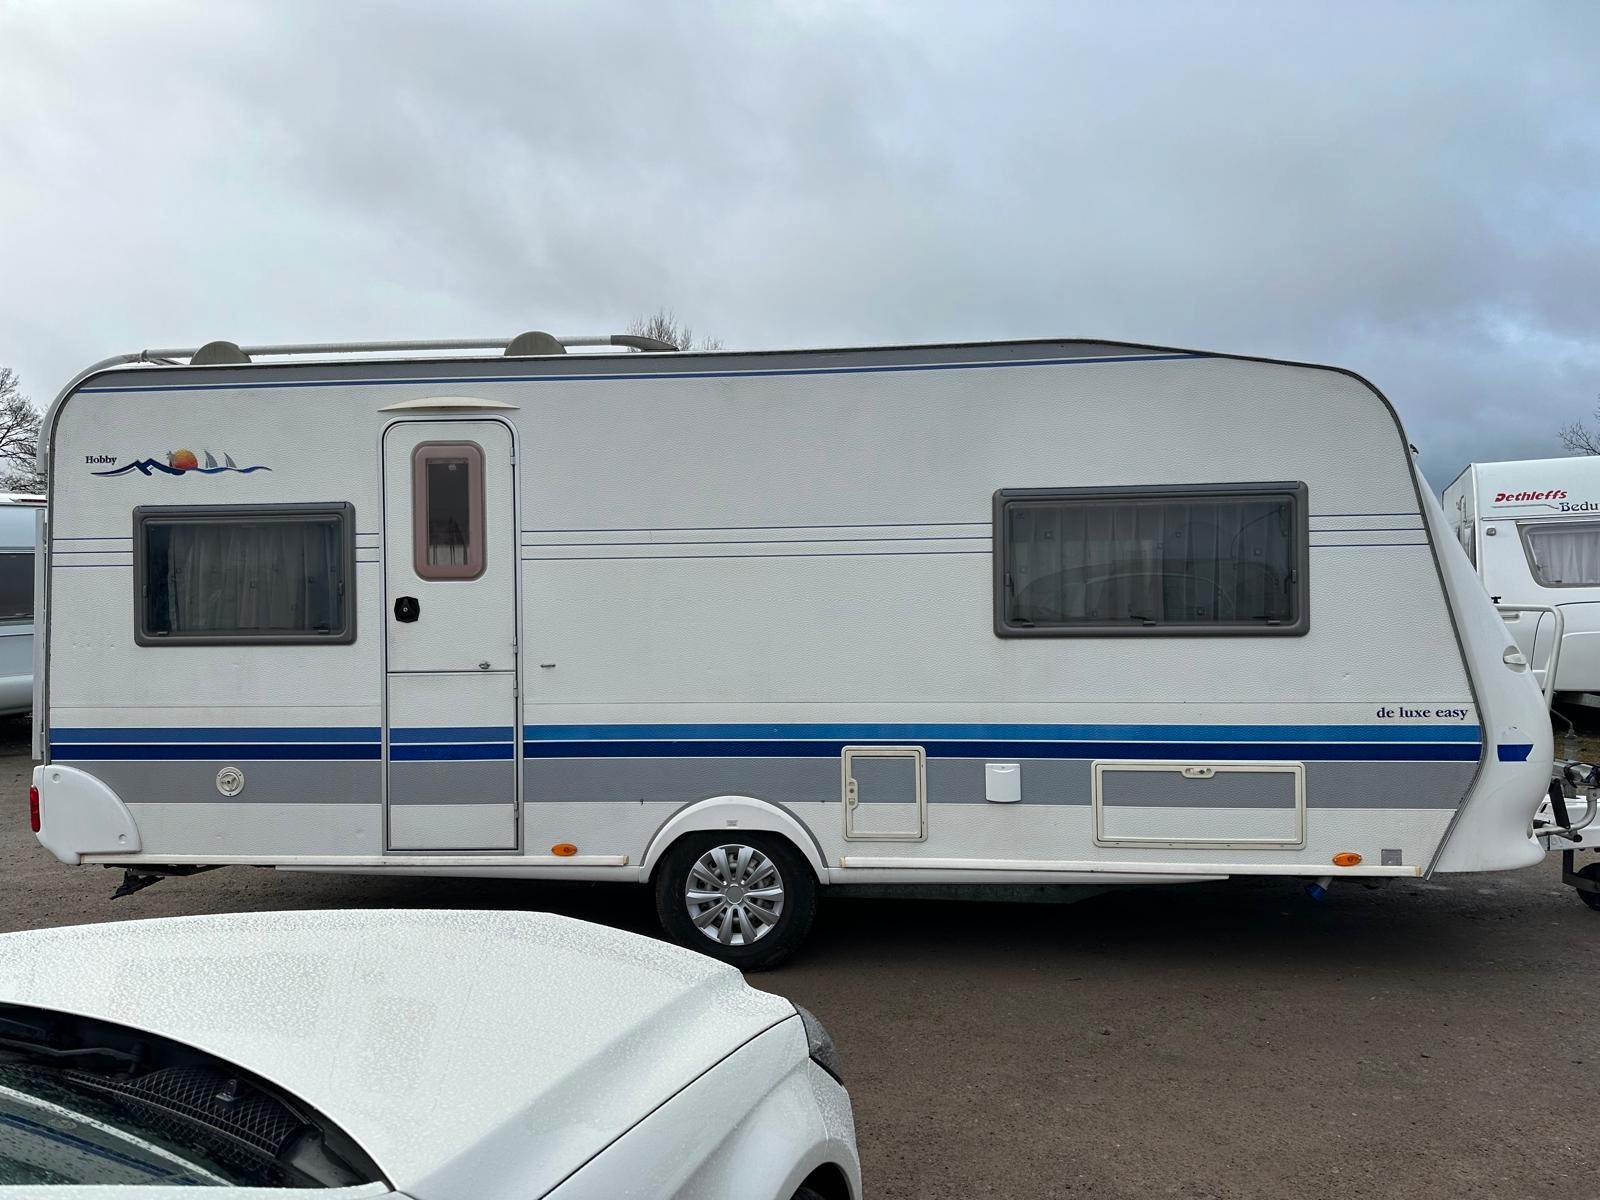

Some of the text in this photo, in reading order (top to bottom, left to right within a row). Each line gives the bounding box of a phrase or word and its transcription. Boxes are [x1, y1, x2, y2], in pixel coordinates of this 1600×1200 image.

[85, 455, 117, 466] Hobby
[1494, 489, 1568, 503] Dethleffs
[1559, 501, 1599, 512] Bedu
[1376, 707, 1468, 720] de luxe easy
